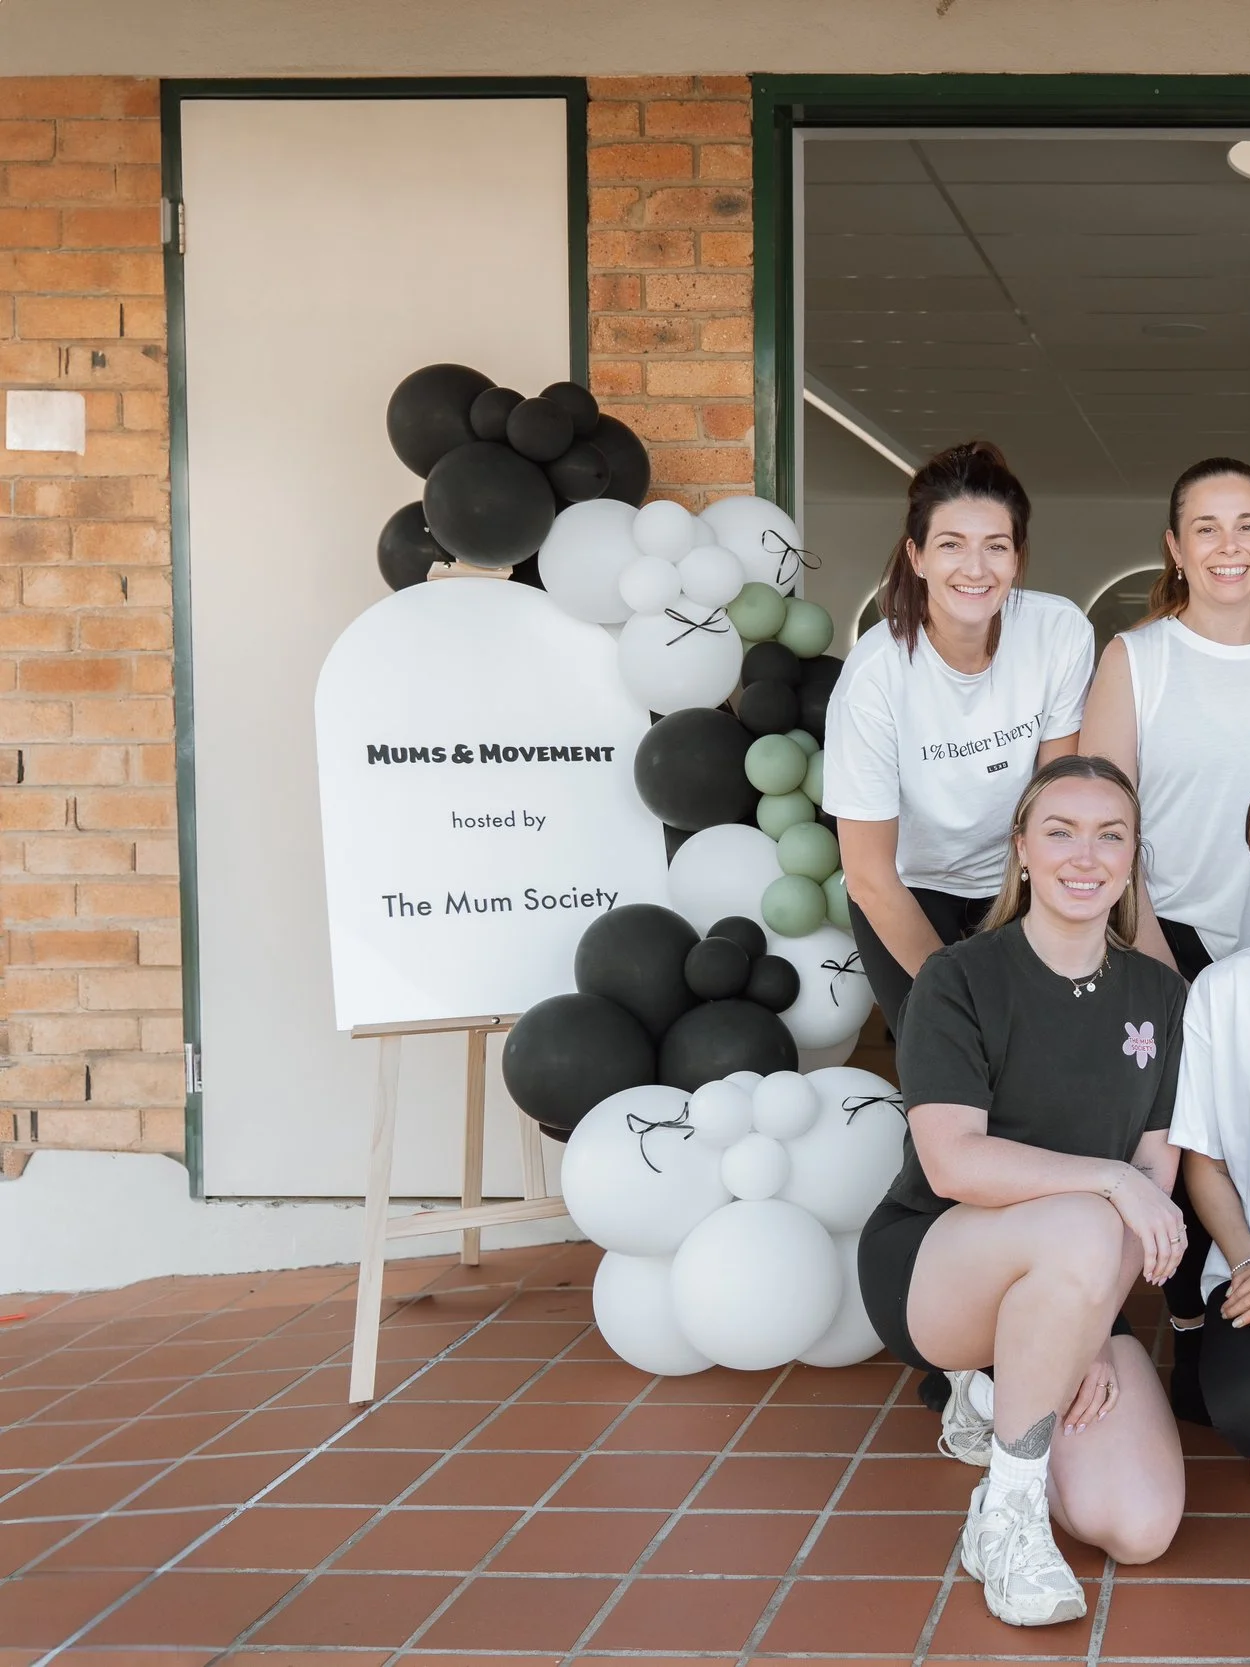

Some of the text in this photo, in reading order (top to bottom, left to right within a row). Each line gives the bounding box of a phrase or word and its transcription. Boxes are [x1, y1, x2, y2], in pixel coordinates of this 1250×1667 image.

[920, 743, 946, 761] 1%
[946, 736, 992, 759] Better
[993, 720, 1034, 748] Every
[451, 743, 474, 764] &
[451, 809, 547, 831] hosted by
[381, 886, 619, 918] The Mum Society
[1131, 1044, 1153, 1052] SOCIETY
